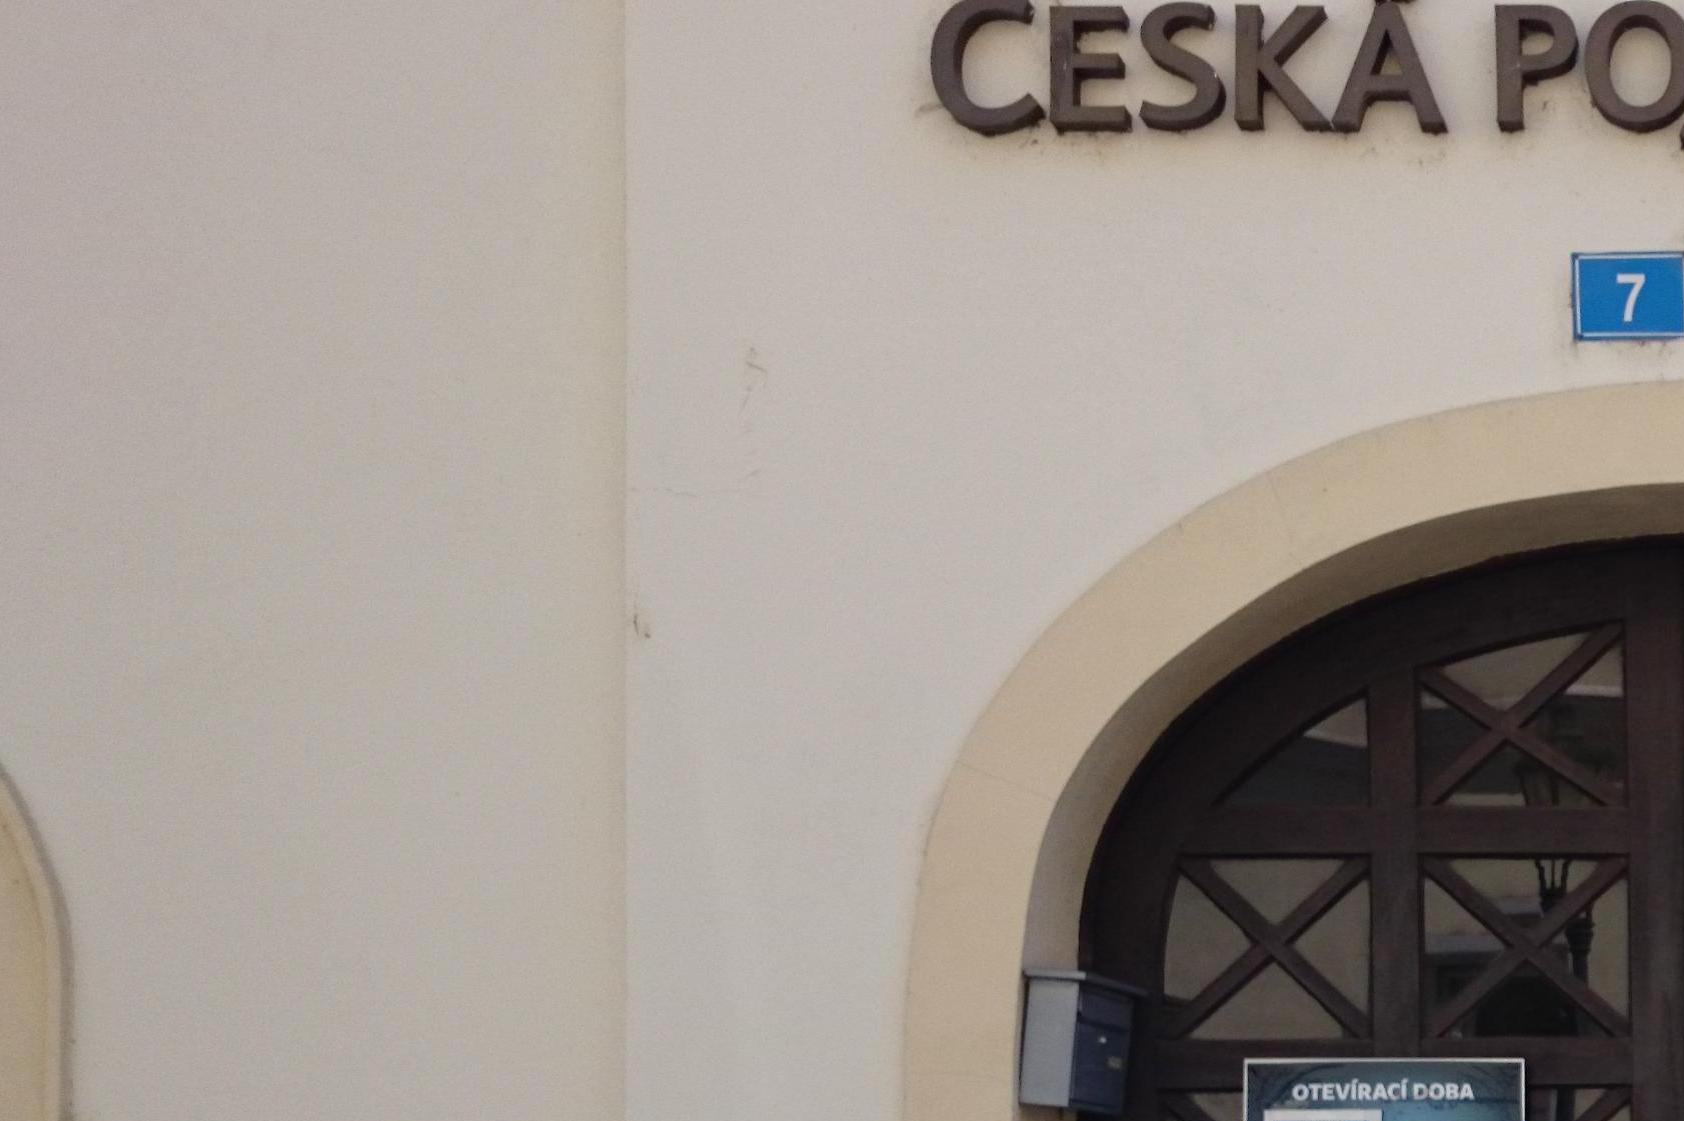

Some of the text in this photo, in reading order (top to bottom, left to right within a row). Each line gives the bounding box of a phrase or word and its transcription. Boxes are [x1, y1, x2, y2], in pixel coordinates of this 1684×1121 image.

[1616, 273, 1645, 323] 7
[1292, 1078, 1475, 1101] OTEVÍRACÍ DOBA
